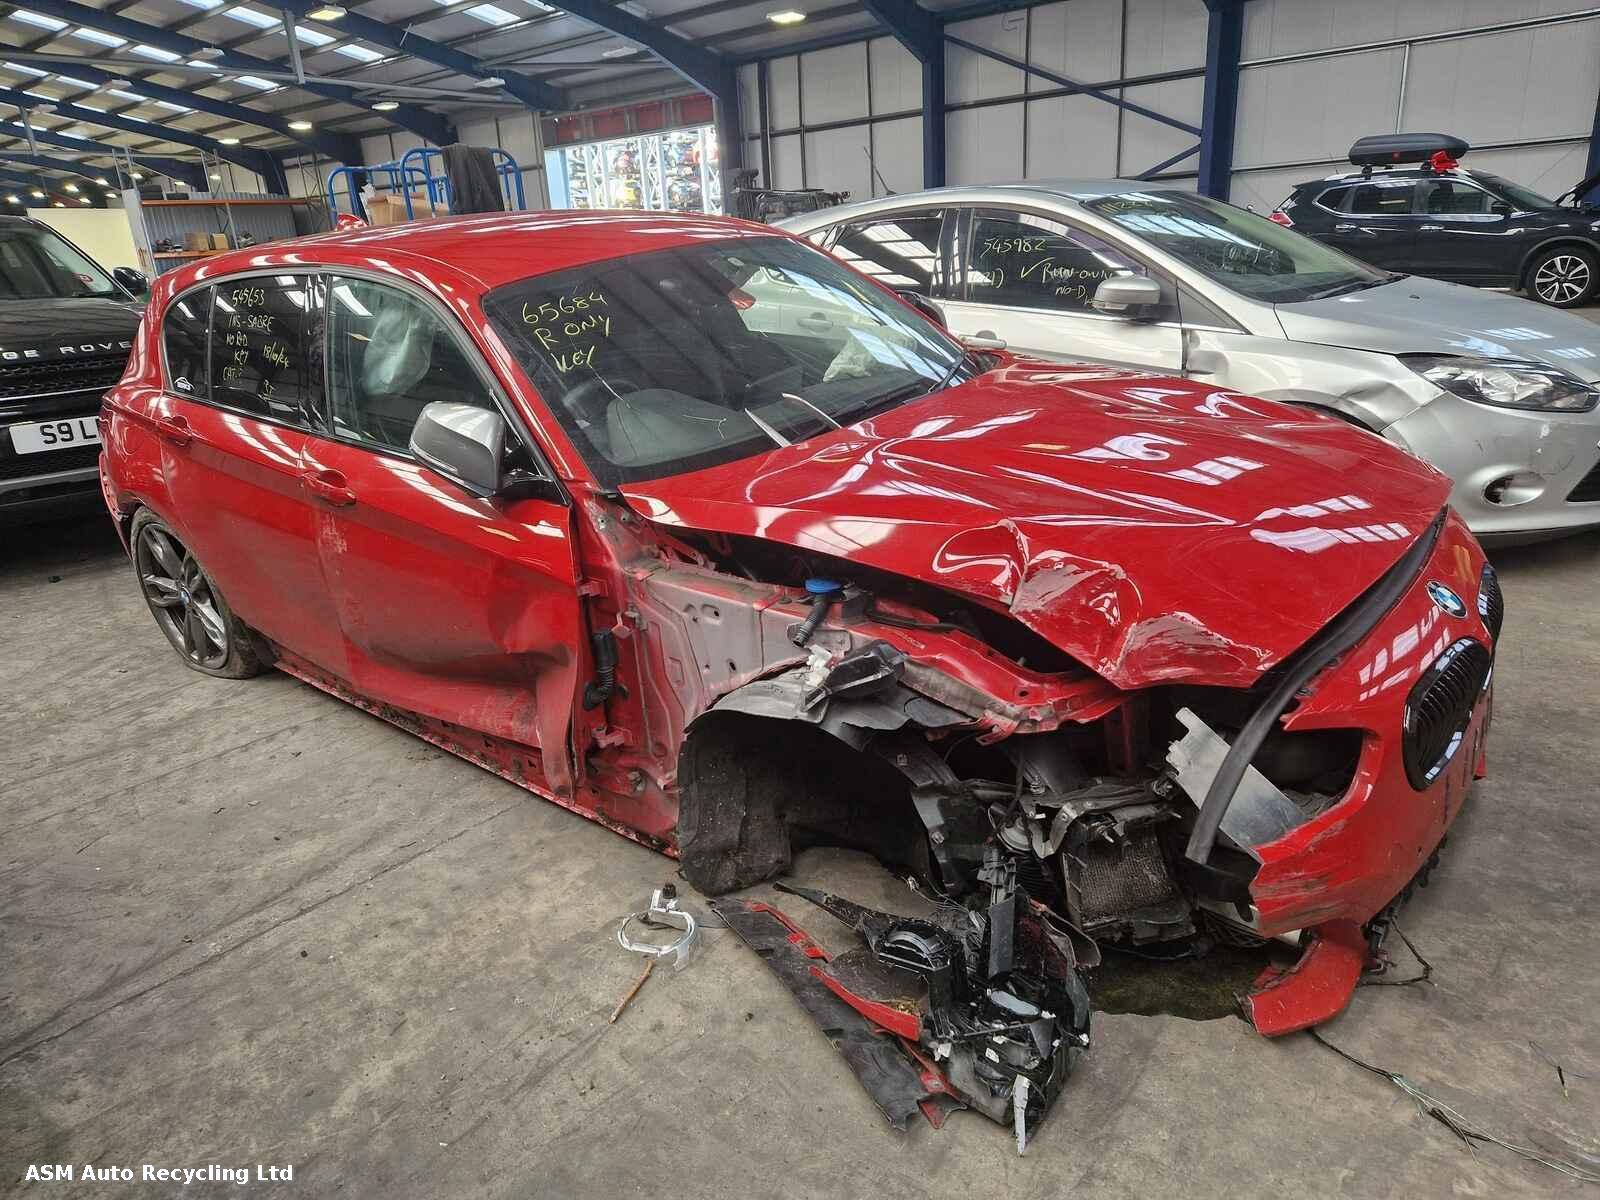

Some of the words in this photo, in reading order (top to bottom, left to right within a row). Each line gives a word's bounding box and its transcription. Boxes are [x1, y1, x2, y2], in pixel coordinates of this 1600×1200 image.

[980, 238, 1048, 258] 545982
[232, 287, 265, 307] 545653
[522, 292, 608, 324] 65684
[40, 422, 74, 445] S9
[79, 418, 99, 440] L
